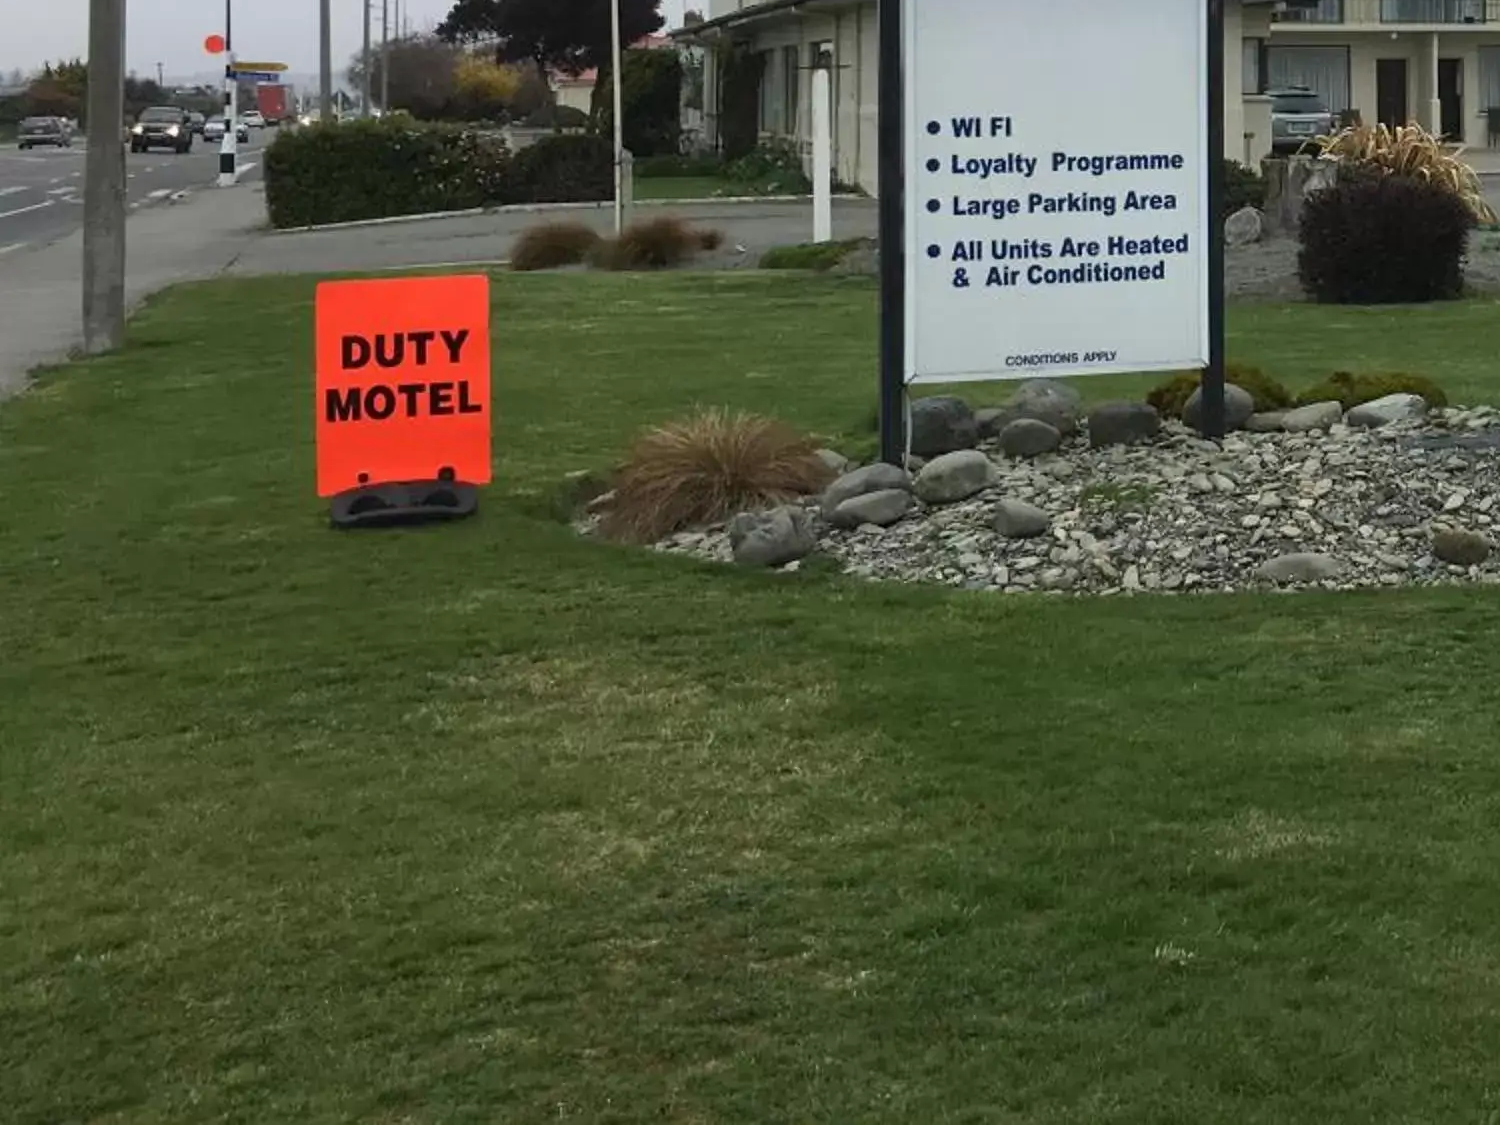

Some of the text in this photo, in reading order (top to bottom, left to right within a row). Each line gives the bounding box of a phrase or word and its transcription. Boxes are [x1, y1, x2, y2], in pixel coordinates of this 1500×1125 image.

[951, 116, 1012, 137] WI FI
[951, 152, 1184, 179] Loyalty Programme
[953, 190, 1177, 219] Large Parking Area
[951, 233, 1188, 261] All Units Are Heated
[952, 260, 1165, 287] & Air Conditioned
[341, 329, 470, 369] DUTY
[1005, 350, 1116, 366] CONDITIONS APPLY
[325, 381, 482, 422] MOTEL
